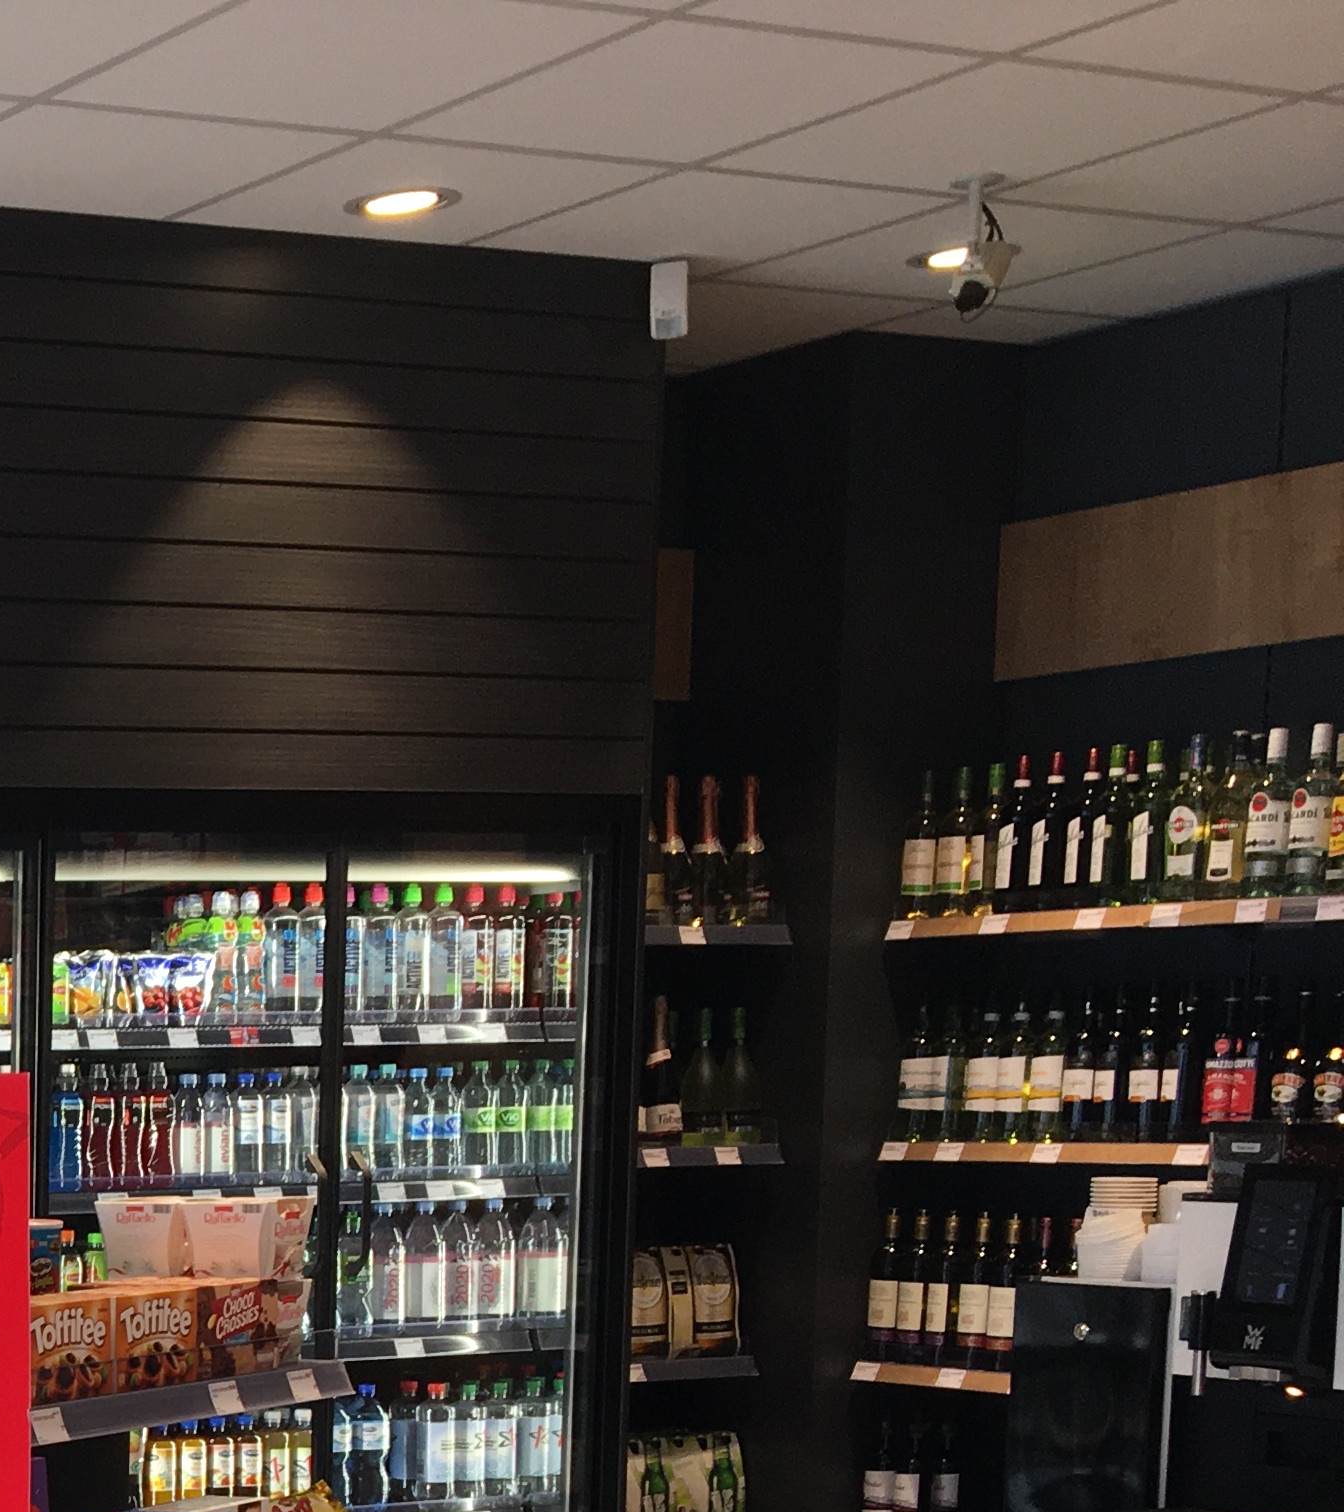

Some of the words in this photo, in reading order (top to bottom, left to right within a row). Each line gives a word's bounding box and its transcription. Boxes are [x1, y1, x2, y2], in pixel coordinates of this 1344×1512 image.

[120, 1297, 192, 1344] Toffifee
[215, 1304, 260, 1341] CROSSIES
[223, 1290, 256, 1316] CHOCO
[31, 1307, 107, 1355] Toffifee
